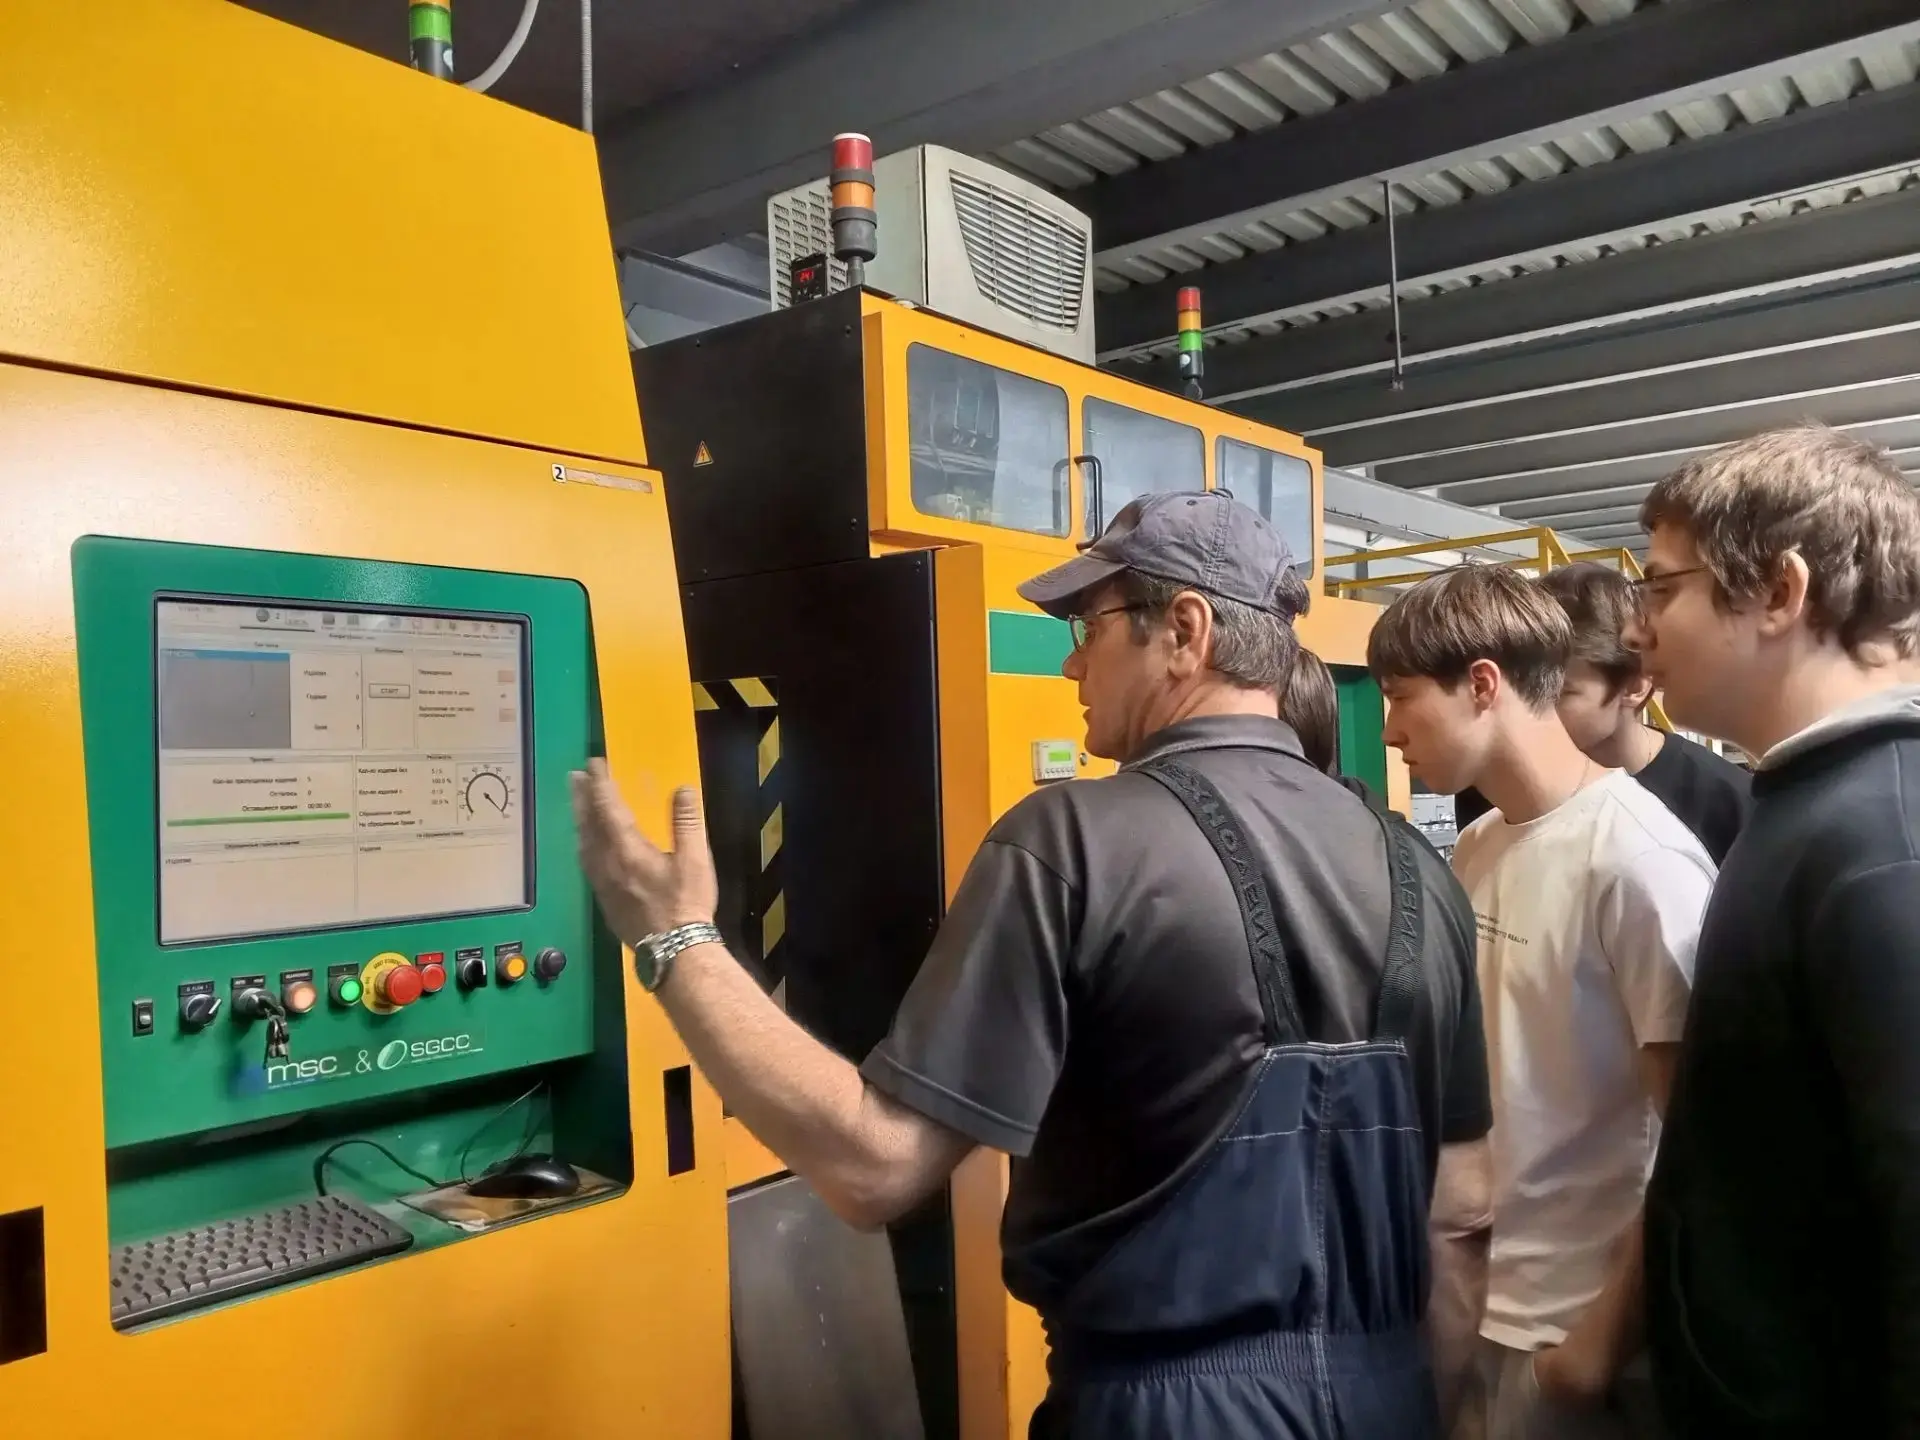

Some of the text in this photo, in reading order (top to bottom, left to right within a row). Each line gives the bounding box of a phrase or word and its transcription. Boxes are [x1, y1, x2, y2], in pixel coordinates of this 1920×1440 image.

[555, 466, 563, 480] 2
[1507, 933, 1528, 946] REALITY
[267, 1055, 338, 1084] msc
[355, 1049, 372, 1074] &
[410, 1033, 470, 1058] SGCC
